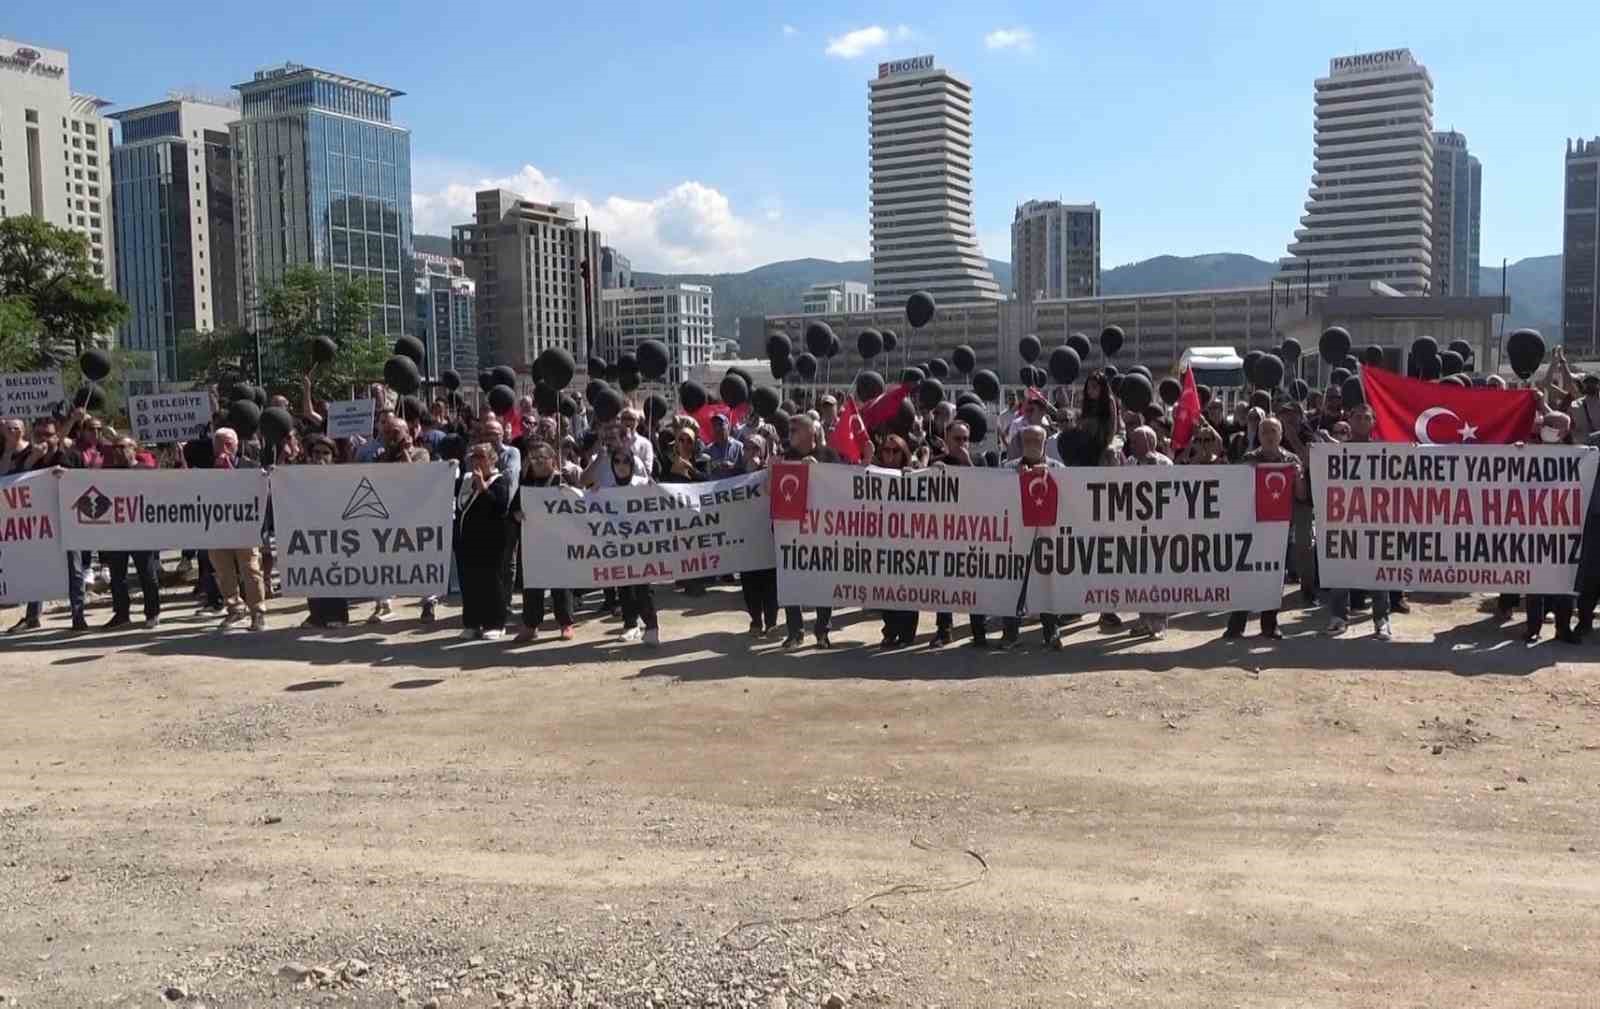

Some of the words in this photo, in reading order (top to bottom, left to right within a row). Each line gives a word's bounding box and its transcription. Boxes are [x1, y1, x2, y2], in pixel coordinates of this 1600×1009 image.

[1334, 49, 1403, 69] HARMONY
[7, 390, 48, 401] KATILIM
[1328, 449, 1361, 480] BİZ
[1367, 449, 1459, 481] TİCARET
[1464, 456, 1581, 482] YAPMADIK
[4, 486, 32, 509] VE
[544, 500, 619, 515] YASAL
[626, 483, 761, 514] DENİLEREK
[853, 470, 882, 501] BİR
[887, 470, 960, 504] AİLENİN
[1087, 480, 1220, 522] TMSF'YE
[114, 494, 260, 531] EVlenemiyoruz!
[801, 509, 820, 535] EV
[824, 504, 883, 539] SAHİBİ
[888, 512, 939, 540] OLMA
[1327, 487, 1473, 525] BARINMA
[1482, 488, 1581, 526] HAKKI
[0, 515, 53, 541] AN'A
[287, 528, 361, 558] ATIŞ
[372, 525, 443, 553] YAPI
[588, 513, 720, 540] YAŞATILAN
[567, 531, 745, 561] MAĞDURİYET...
[780, 539, 839, 572] TİCARİ
[843, 540, 872, 574] BİR
[876, 549, 940, 576] FIRSAT
[1034, 526, 1280, 575] GÜVENİYORUZ...
[1325, 531, 1357, 560] EN
[1364, 531, 1448, 562] TEMEL
[1455, 532, 1582, 564] HAKKIMIZ
[287, 561, 444, 588] MAĞDURLARI
[593, 561, 672, 582] HELAL
[681, 555, 721, 574] Mİ?
[1375, 568, 1413, 587] ATIŞ
[1419, 567, 1530, 584] MAĞDURLARI
[833, 584, 867, 606] ATIŞ
[872, 584, 977, 606] MAĞDURLARI
[1085, 588, 1120, 607] ATIŞ
[1125, 585, 1230, 604] MAĞDURLARI
